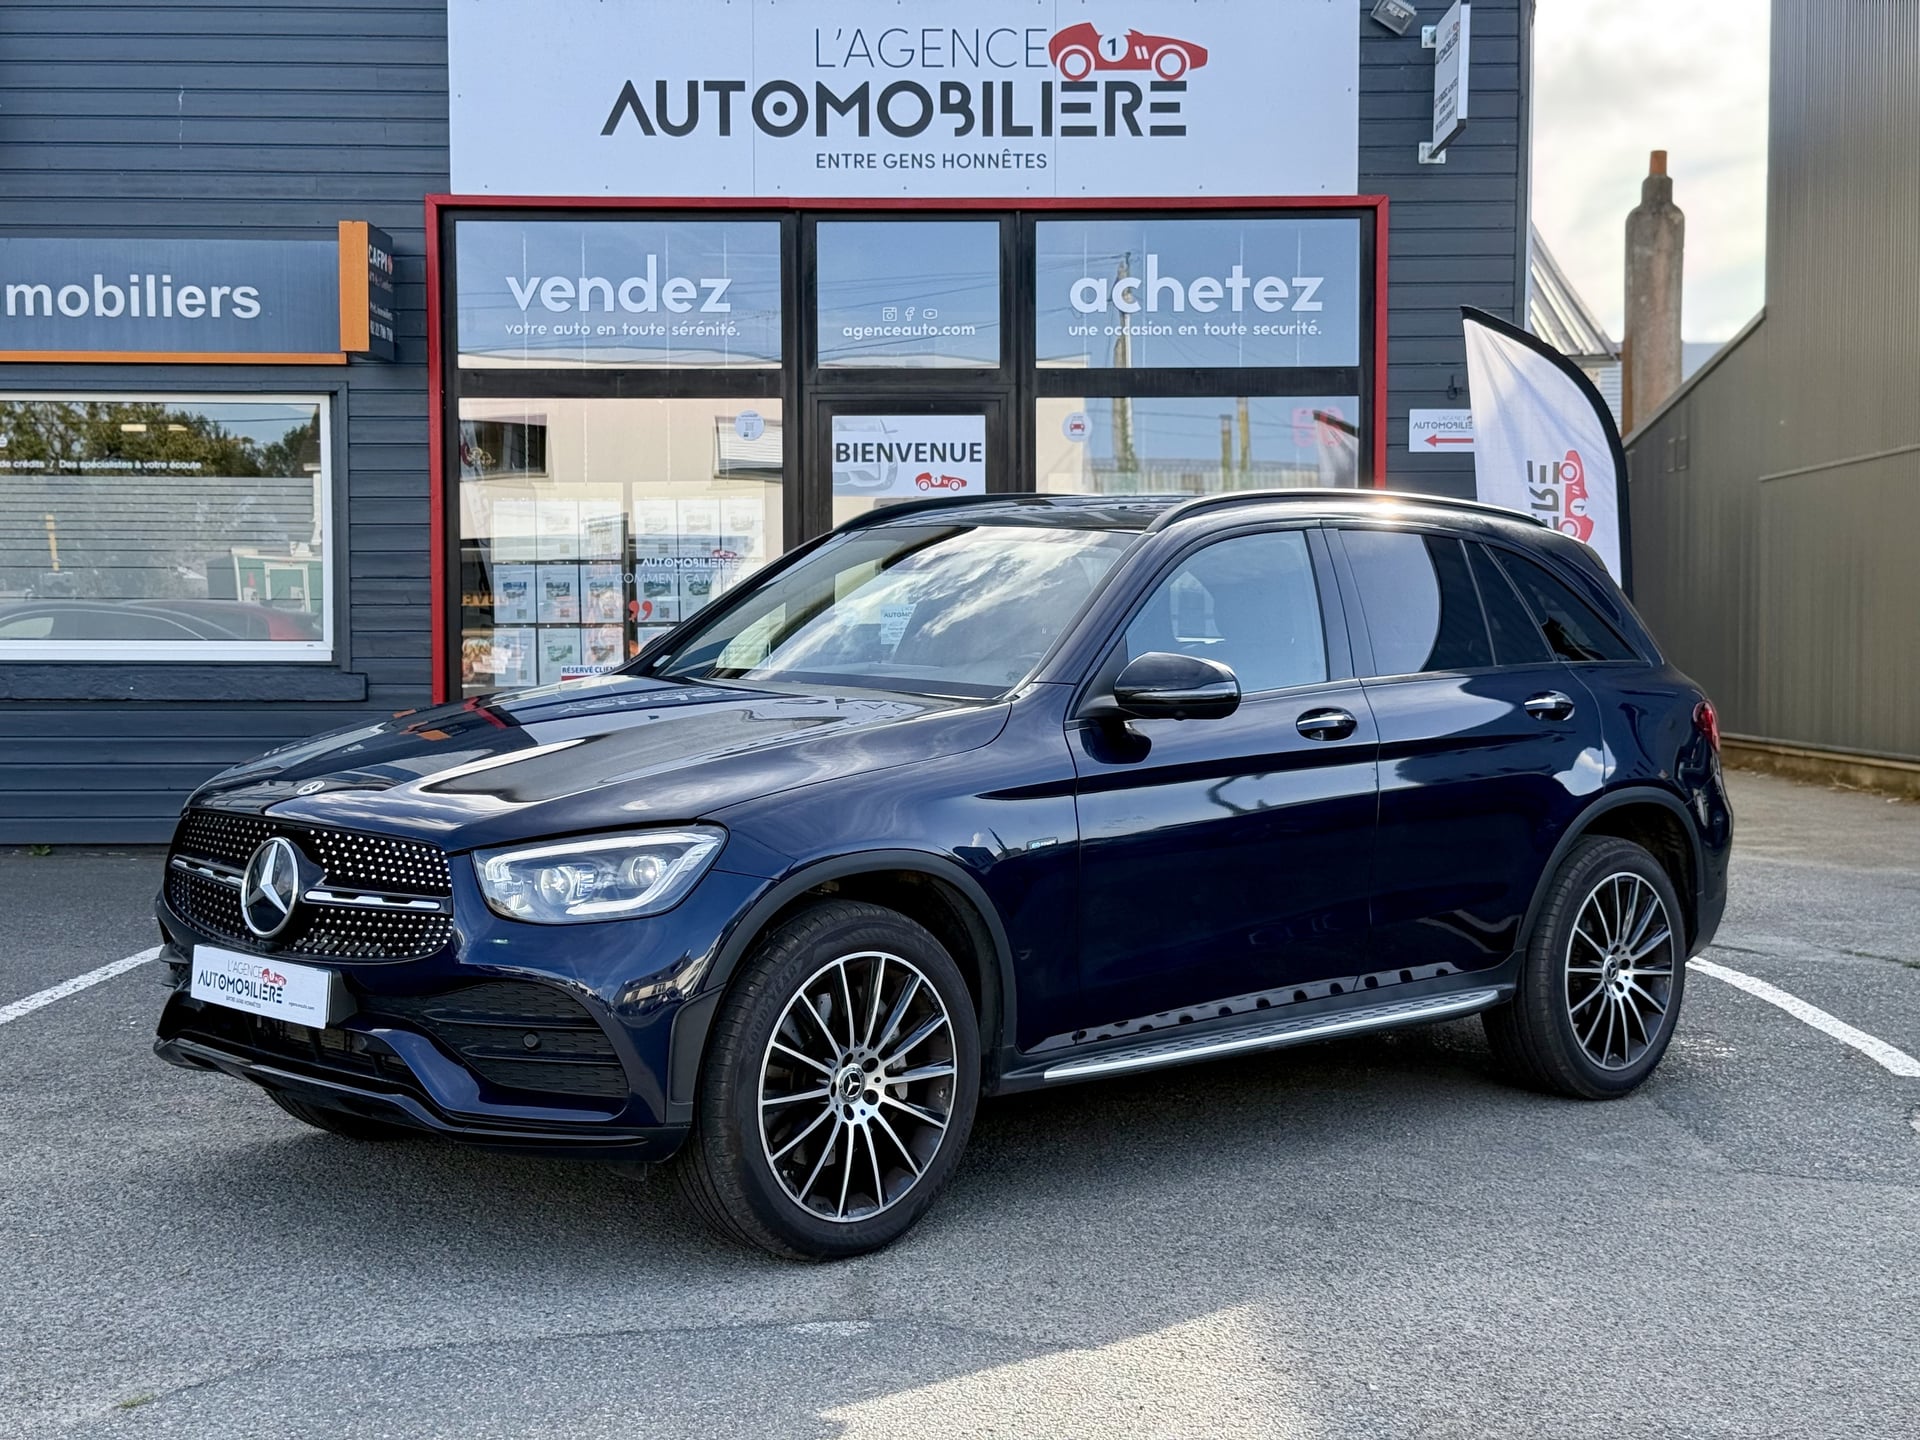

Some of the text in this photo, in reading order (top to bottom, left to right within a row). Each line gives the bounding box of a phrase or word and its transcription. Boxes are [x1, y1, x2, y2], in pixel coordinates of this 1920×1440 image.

[816, 149, 1048, 169] ENTRE GENS HONNÊTES
[505, 254, 733, 313] vendez
[1069, 255, 1324, 313] achetez
[6, 274, 261, 319] mobiliers
[505, 321, 741, 336] votre auto en toute sérénité.
[842, 324, 976, 341] agenceauto.com
[1068, 325, 1099, 336] une
[1104, 322, 1173, 337] occasion
[1178, 325, 1198, 336] en
[1203, 322, 1247, 336] toute
[834, 442, 983, 463] BIENVENUE
[13, 459, 45, 469] crédits
[59, 460, 78, 469] Des
[79, 458, 133, 471] spécialistes
[143, 460, 168, 469] votre
[169, 458, 202, 470] écoute
[561, 665, 594, 674] RÉSERVÉ
[226, 960, 263, 980] L'AGENCE
